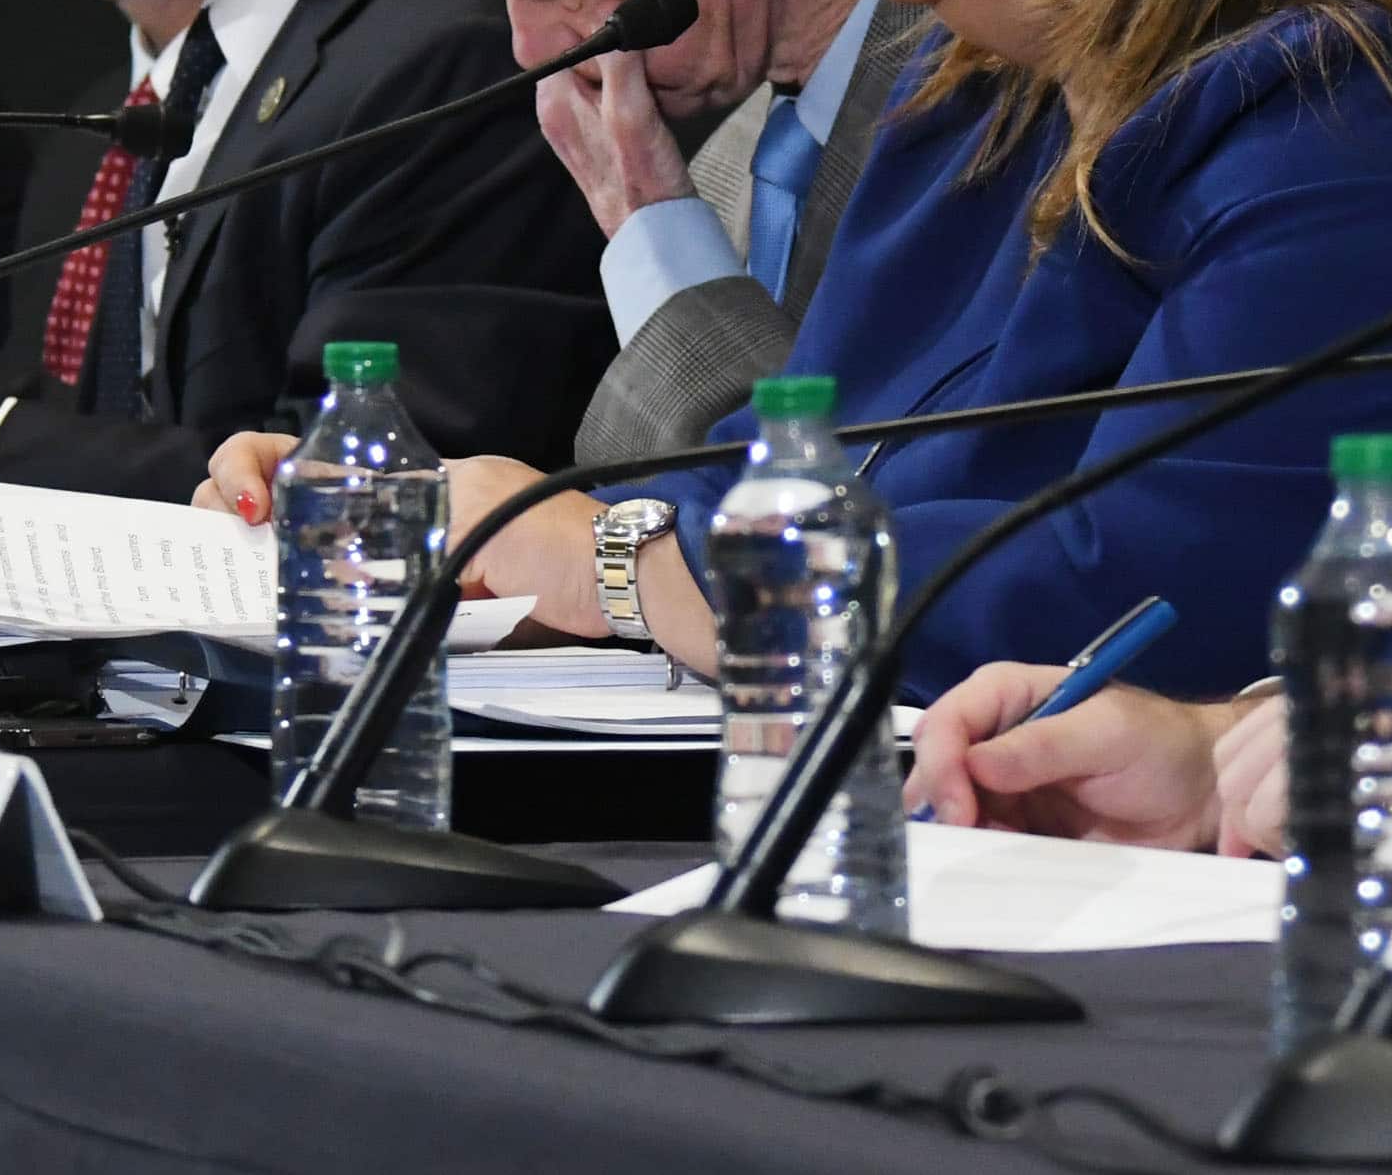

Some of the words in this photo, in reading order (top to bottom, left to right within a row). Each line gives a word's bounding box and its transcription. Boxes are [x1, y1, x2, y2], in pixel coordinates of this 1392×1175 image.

[56, 523, 69, 541] and
[128, 532, 143, 571] requires
[160, 539, 173, 567] timely
[222, 545, 235, 566] that
[226, 568, 245, 615] paramount
[258, 569, 272, 599] learns
